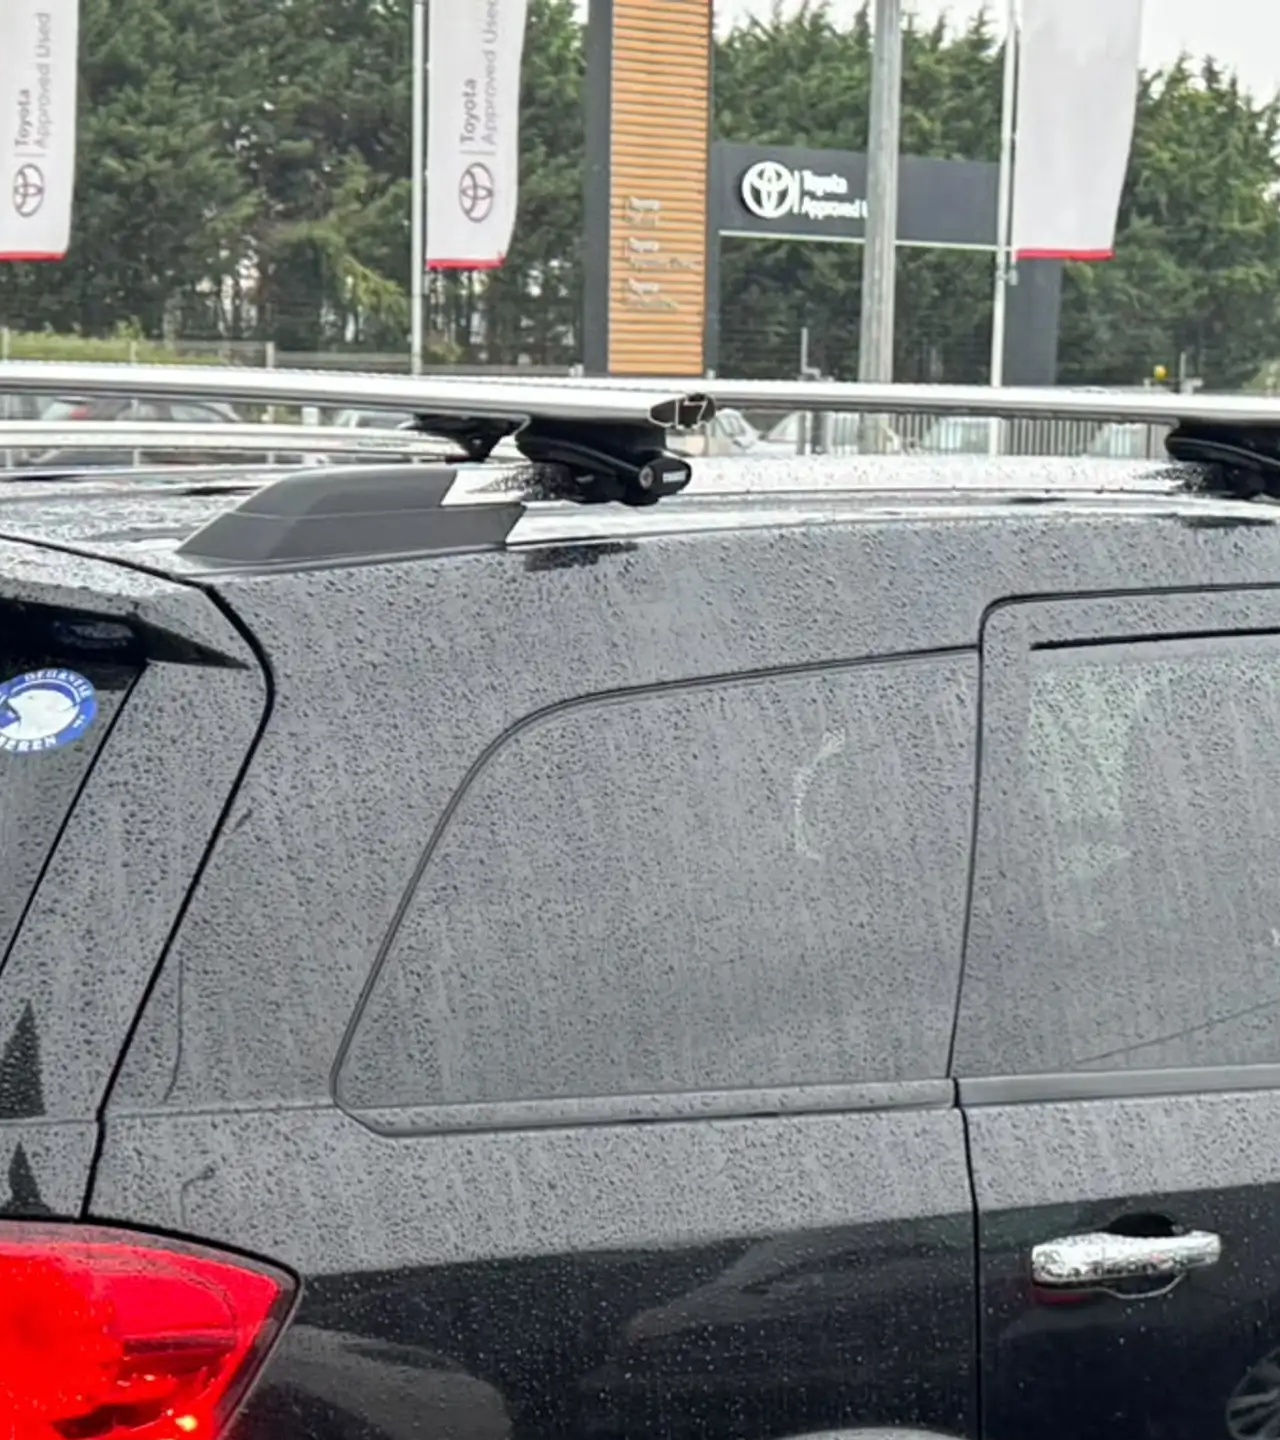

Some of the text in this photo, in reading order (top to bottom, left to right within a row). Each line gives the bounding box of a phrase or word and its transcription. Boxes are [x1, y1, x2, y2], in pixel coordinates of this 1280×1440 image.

[14, 88, 33, 147] Toyota
[33, 12, 54, 149] Approved Used
[460, 78, 481, 145] Toyota
[480, 49, 499, 146] Approved
